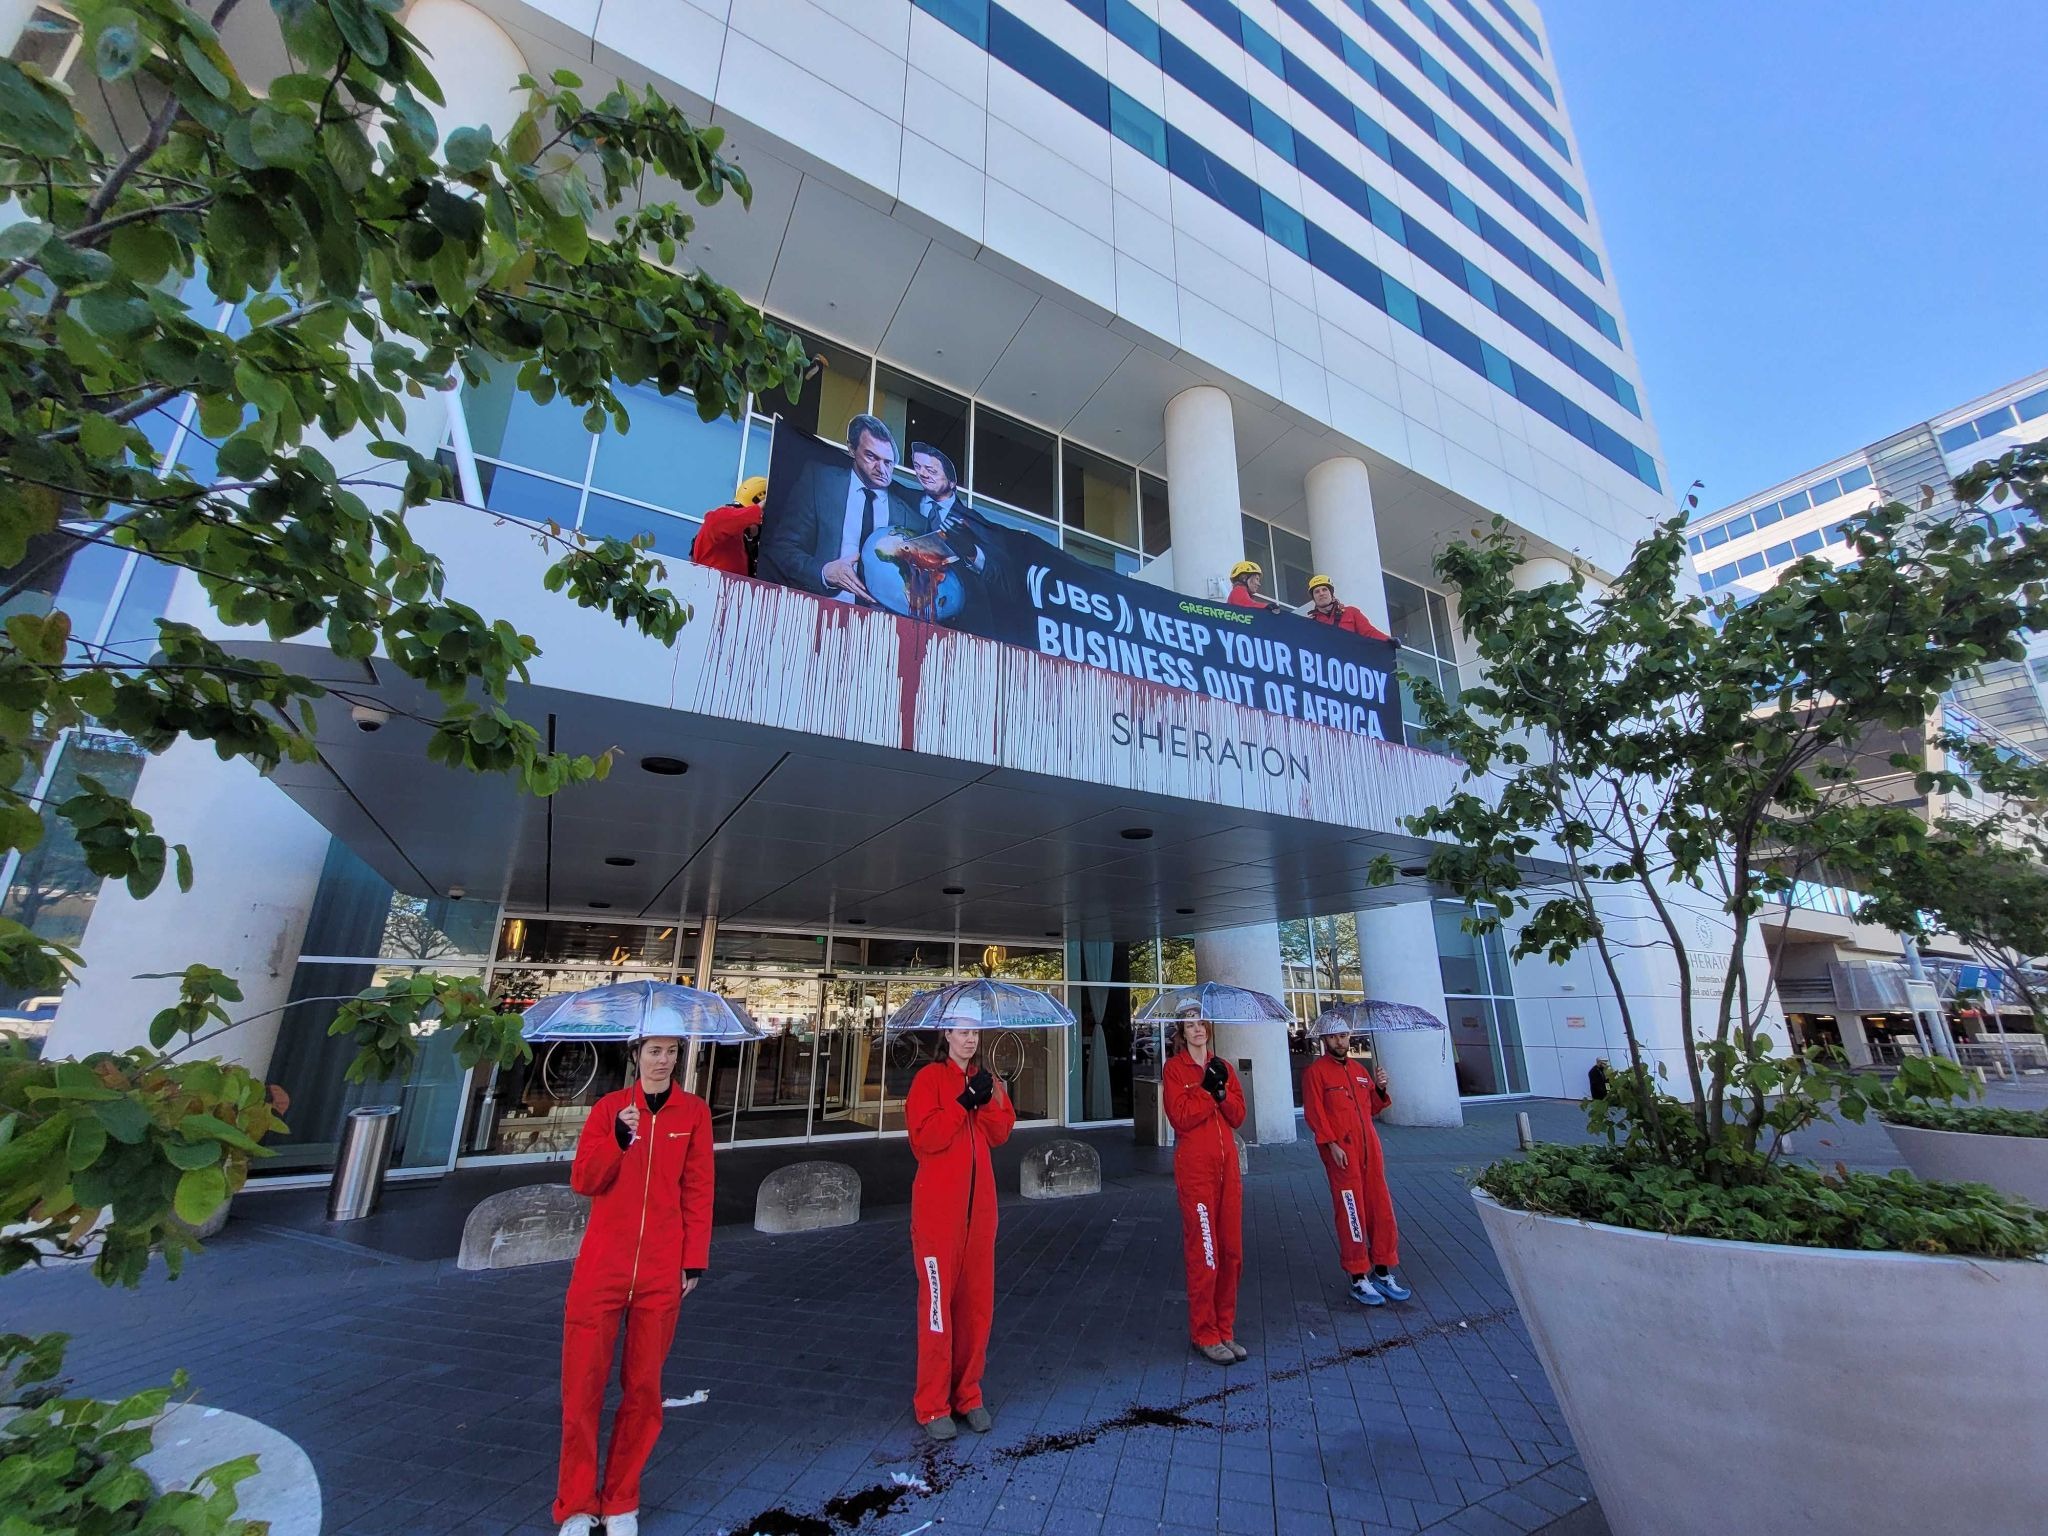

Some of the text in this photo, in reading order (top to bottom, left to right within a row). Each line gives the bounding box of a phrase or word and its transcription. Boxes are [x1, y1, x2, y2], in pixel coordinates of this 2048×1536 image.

[1048, 579, 1389, 704] JBS KEEP YOUR BLOODY
[1178, 600, 1255, 625] GREENPEACE
[1038, 615, 1384, 741] BUSINESS OUT OF AFRICA
[1111, 712, 1311, 783] SHERATON
[1196, 1202, 1216, 1270] GREENPEACE
[1344, 1191, 1361, 1241] GREENPEACE
[929, 1260, 939, 1329] GREENPEACE
